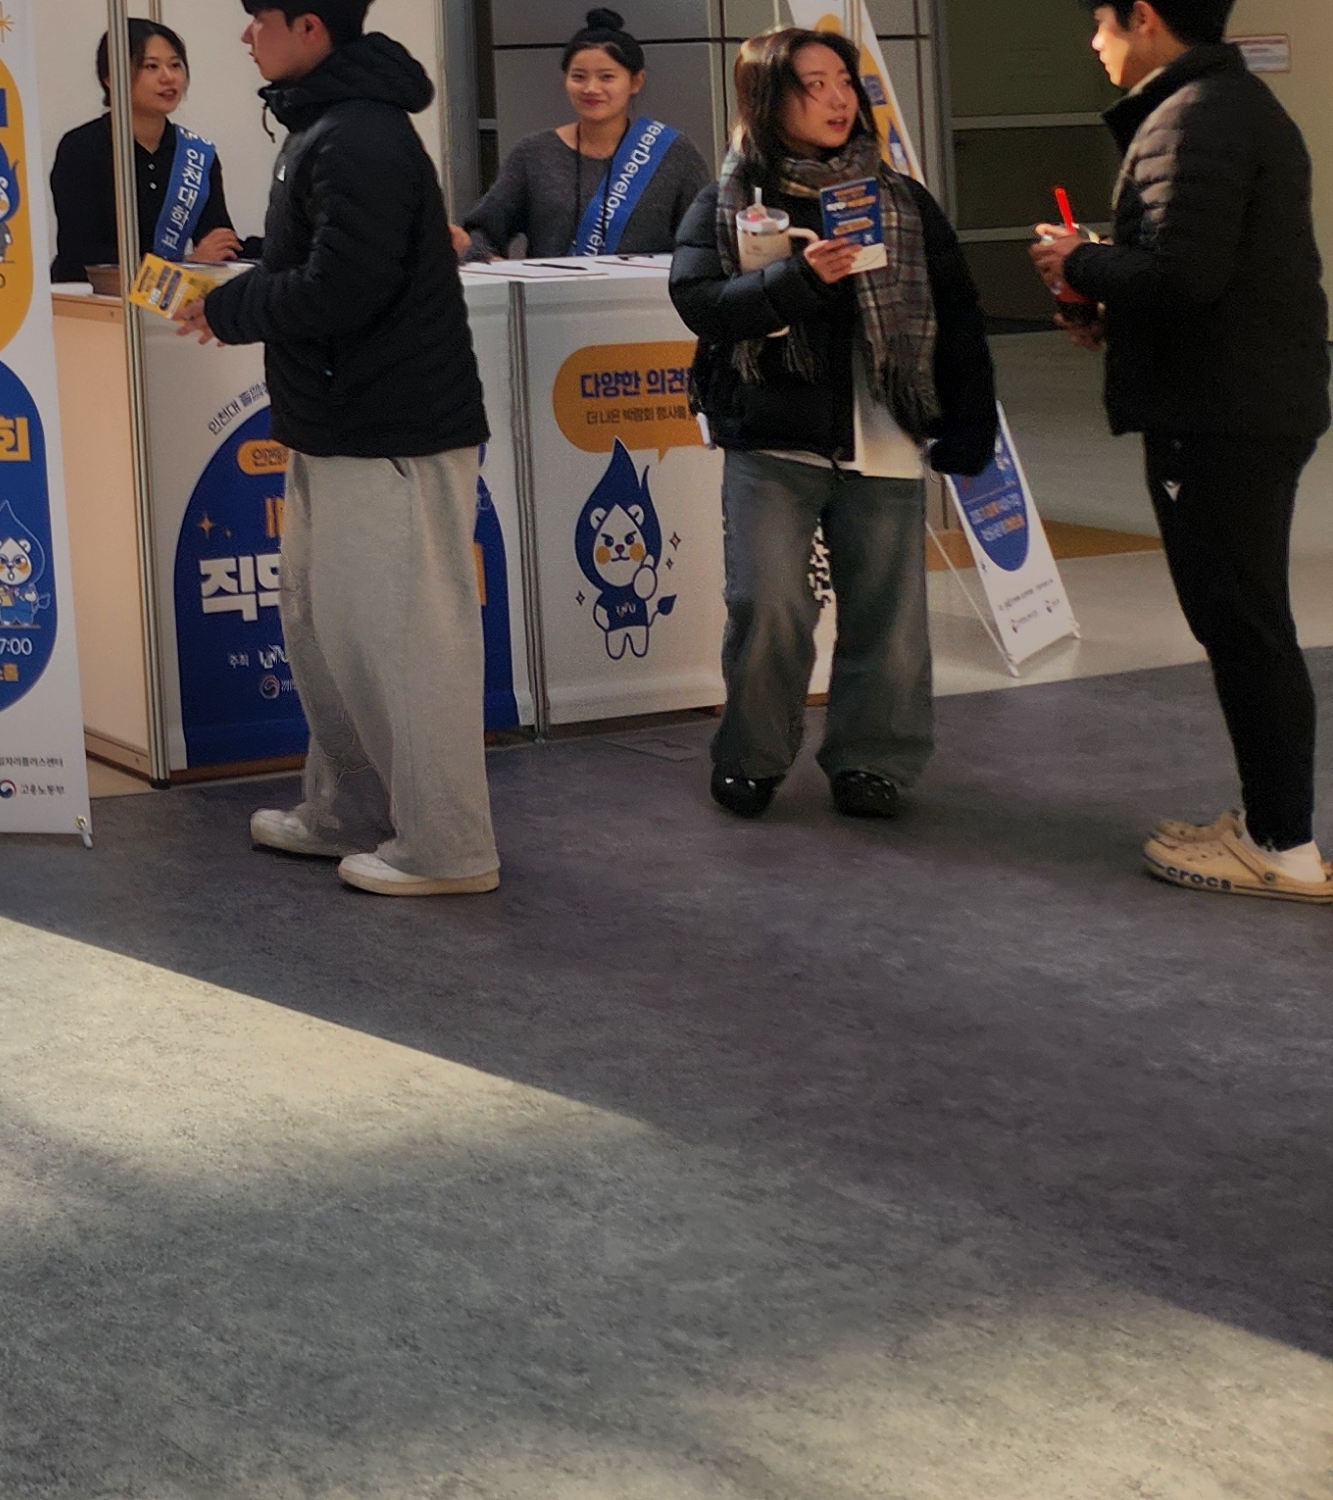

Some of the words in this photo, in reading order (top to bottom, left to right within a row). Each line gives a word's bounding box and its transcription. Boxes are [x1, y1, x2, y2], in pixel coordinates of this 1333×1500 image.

[161, 148, 205, 250] 인천대학교
[581, 371, 640, 398] 다양한
[647, 368, 690, 394] 의견
[1166, 866, 1232, 890] crocs
